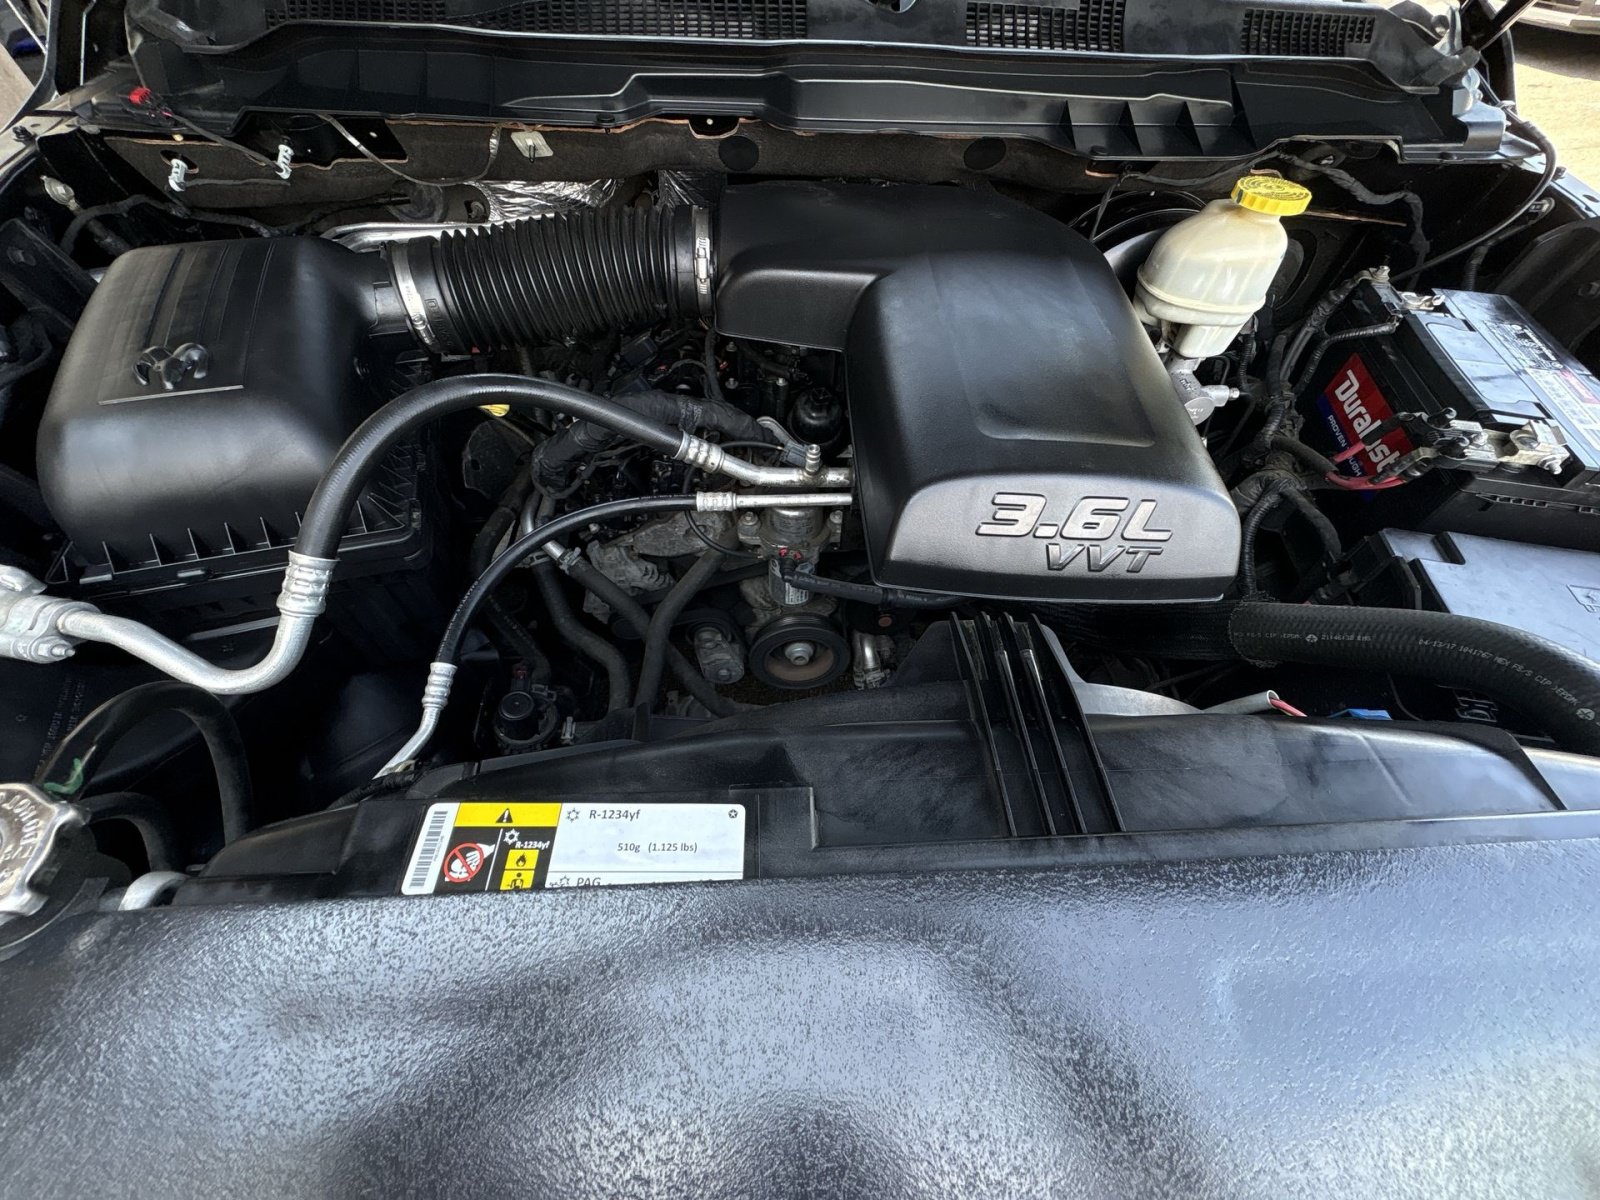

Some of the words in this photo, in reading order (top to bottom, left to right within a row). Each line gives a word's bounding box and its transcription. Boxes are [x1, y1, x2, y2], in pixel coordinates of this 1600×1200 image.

[1328, 414, 1347, 448] PROVEN
[975, 491, 1173, 542] 3.6L
[1046, 542, 1163, 573] VVT
[589, 809, 641, 822] R-1234yf
[514, 840, 551, 850] R-1234yf
[617, 843, 640, 853] 510g
[647, 842, 678, 853] (1.125
[680, 842, 698, 853] lbs)
[577, 877, 602, 887] PAG
